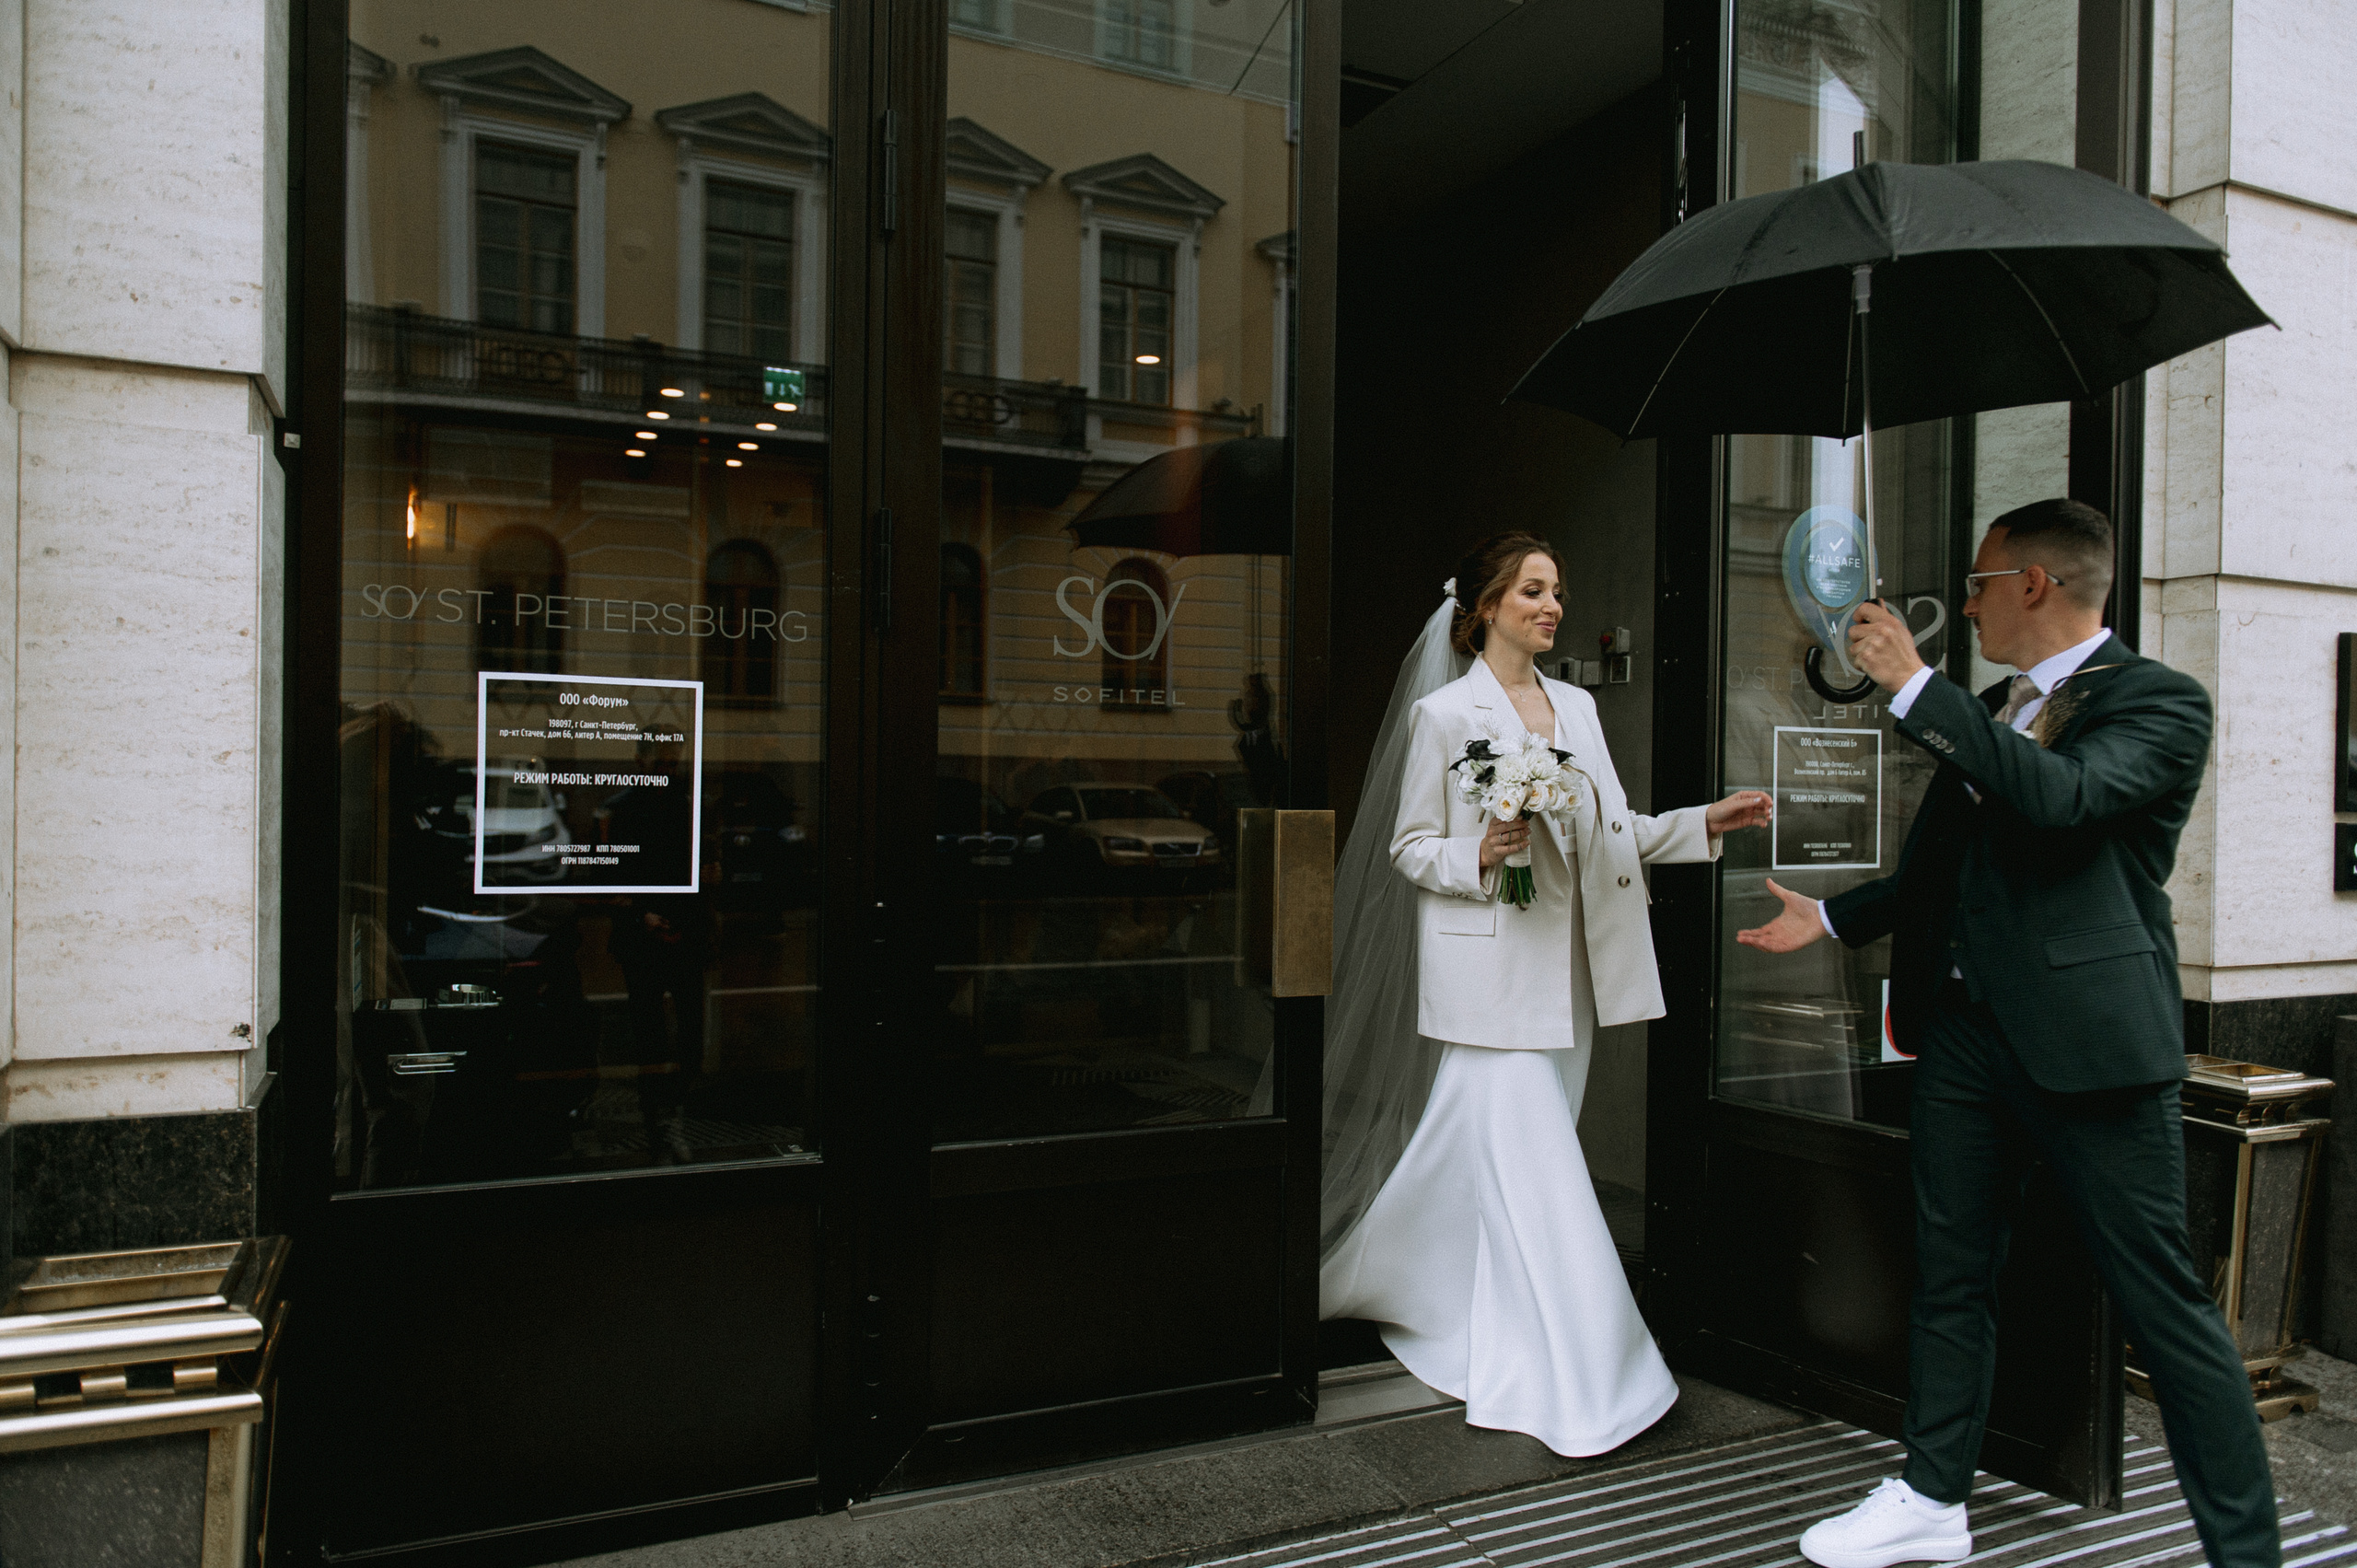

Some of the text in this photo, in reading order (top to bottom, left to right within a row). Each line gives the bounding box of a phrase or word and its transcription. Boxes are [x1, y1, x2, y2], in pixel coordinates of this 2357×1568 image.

[1807, 554, 1861, 569] #ALLSAFE
[436, 587, 497, 626] ST.
[516, 592, 808, 643] PETERSBURG
[559, 693, 630, 709] ООО «Форум»
[1053, 686, 1187, 706] SOFITEL
[548, 718, 575, 730] 198097,
[579, 721, 639, 733] Санкт-Петербург,
[499, 728, 520, 738] пр-кт
[520, 728, 547, 739] Стачек,
[547, 731, 562, 739] дом
[562, 729, 574, 740] 66,
[575, 732, 595, 741] литер
[603, 732, 644, 743] помещение
[655, 733, 673, 745] офис
[1800, 738, 1812, 747] ООО
[513, 772, 669, 787] РЕЖИМ РАБОТЫ: КРУГЛОСУТОЧНО
[1790, 794, 1865, 804] РЕЖИМ РАБОТЫ: КРУГЛОСУТОЧНО
[556, 844, 591, 853] 7805727987
[610, 844, 639, 853] 780501001
[561, 856, 577, 865] ОГРН
